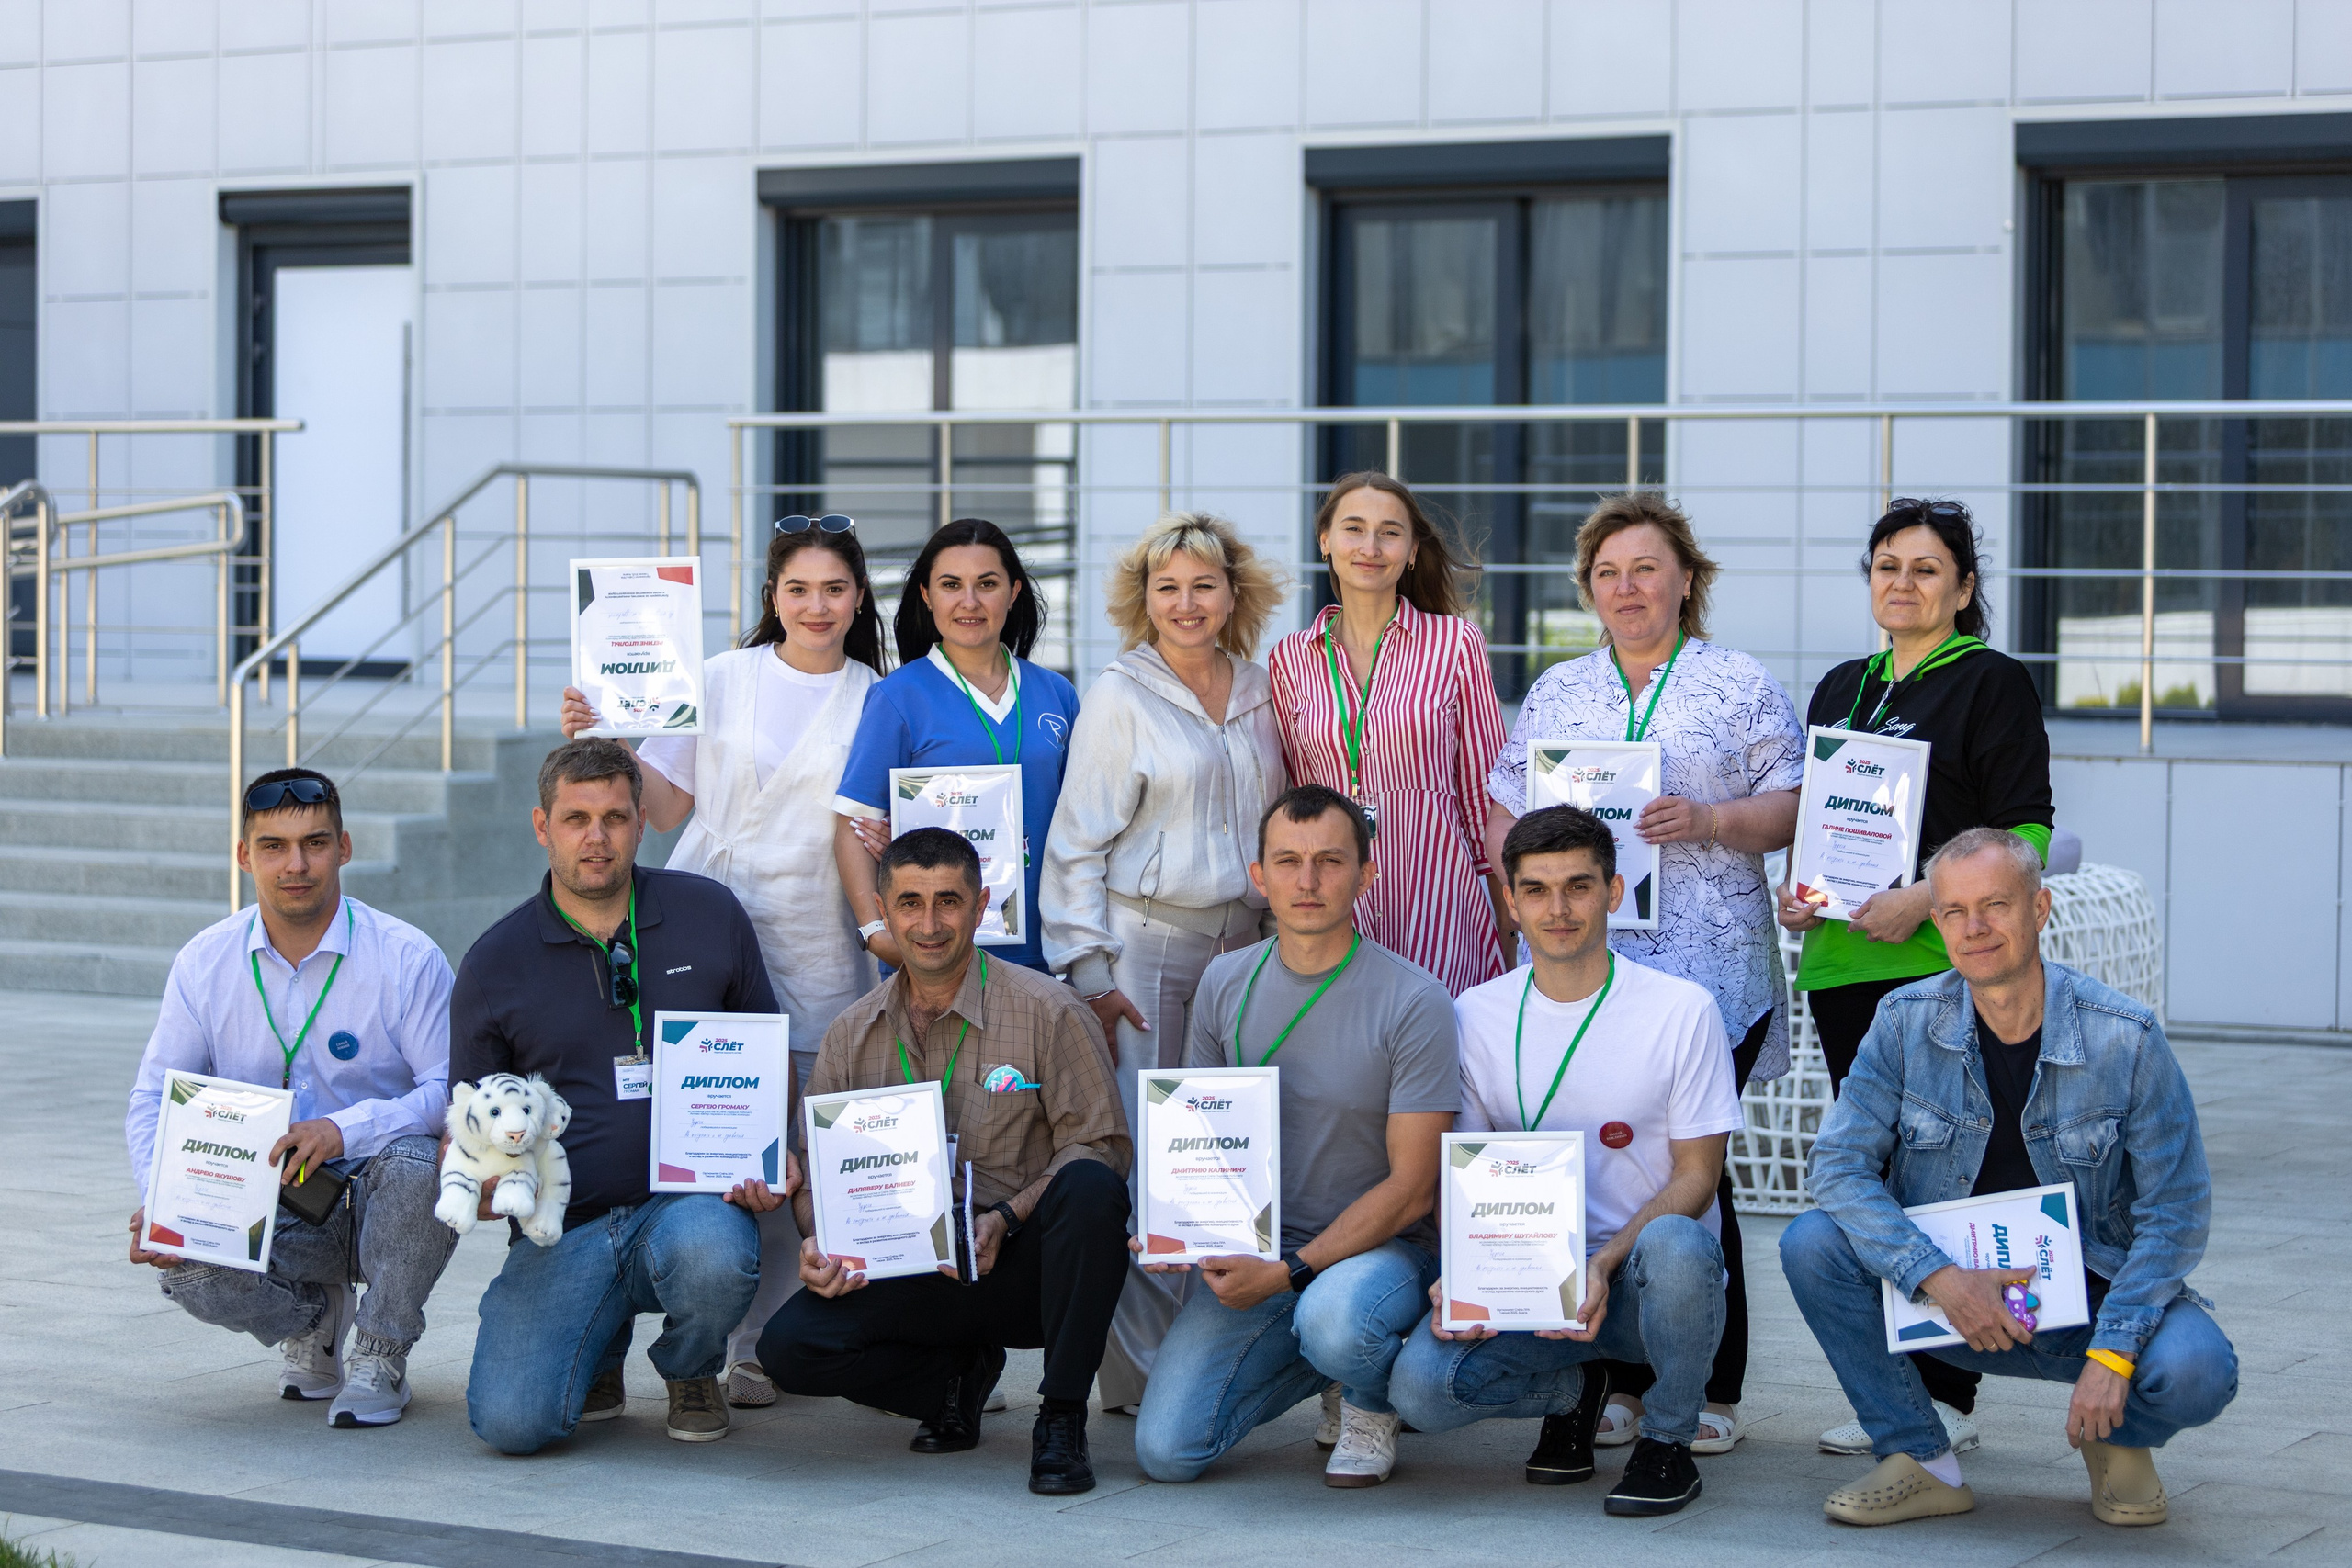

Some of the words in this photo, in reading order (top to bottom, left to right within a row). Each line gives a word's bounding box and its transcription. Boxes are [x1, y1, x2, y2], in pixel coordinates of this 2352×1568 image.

[600, 660, 676, 675] ДИПЛОМ
[1586, 771, 1617, 781] СЛЁТ
[1857, 764, 1884, 776] СЛЁТ
[949, 794, 978, 805] СЛЁТ
[1824, 795, 1894, 818] ДИПЛОМ
[1822, 824, 1845, 832] ГАЛИНЕ
[1845, 828, 1893, 840] ПОШИВАЛОВОЙ
[714, 1041, 744, 1051] СЛЁТ
[623, 1080, 649, 1089] СЕРГЕЙ
[681, 1076, 760, 1089] ДИПЛОМ
[1201, 1099, 1232, 1110] СЛЁТ
[218, 1110, 247, 1122] СЛЁТ
[867, 1117, 898, 1129] СЛЁТ
[182, 1138, 257, 1163] ДИПЛОМ
[1168, 1137, 1250, 1153] ДИПЛОМ
[840, 1151, 919, 1174] ДИПЛОМ
[186, 1168, 214, 1177] АНДРЕЮ
[1505, 1164, 1536, 1174] СЛЁТ
[1471, 1202, 1555, 1217] ДИПЛОМ
[1969, 1222, 1979, 1258] ДМИТРИЮ
[2039, 1249, 2053, 1280] СЛЁТ
